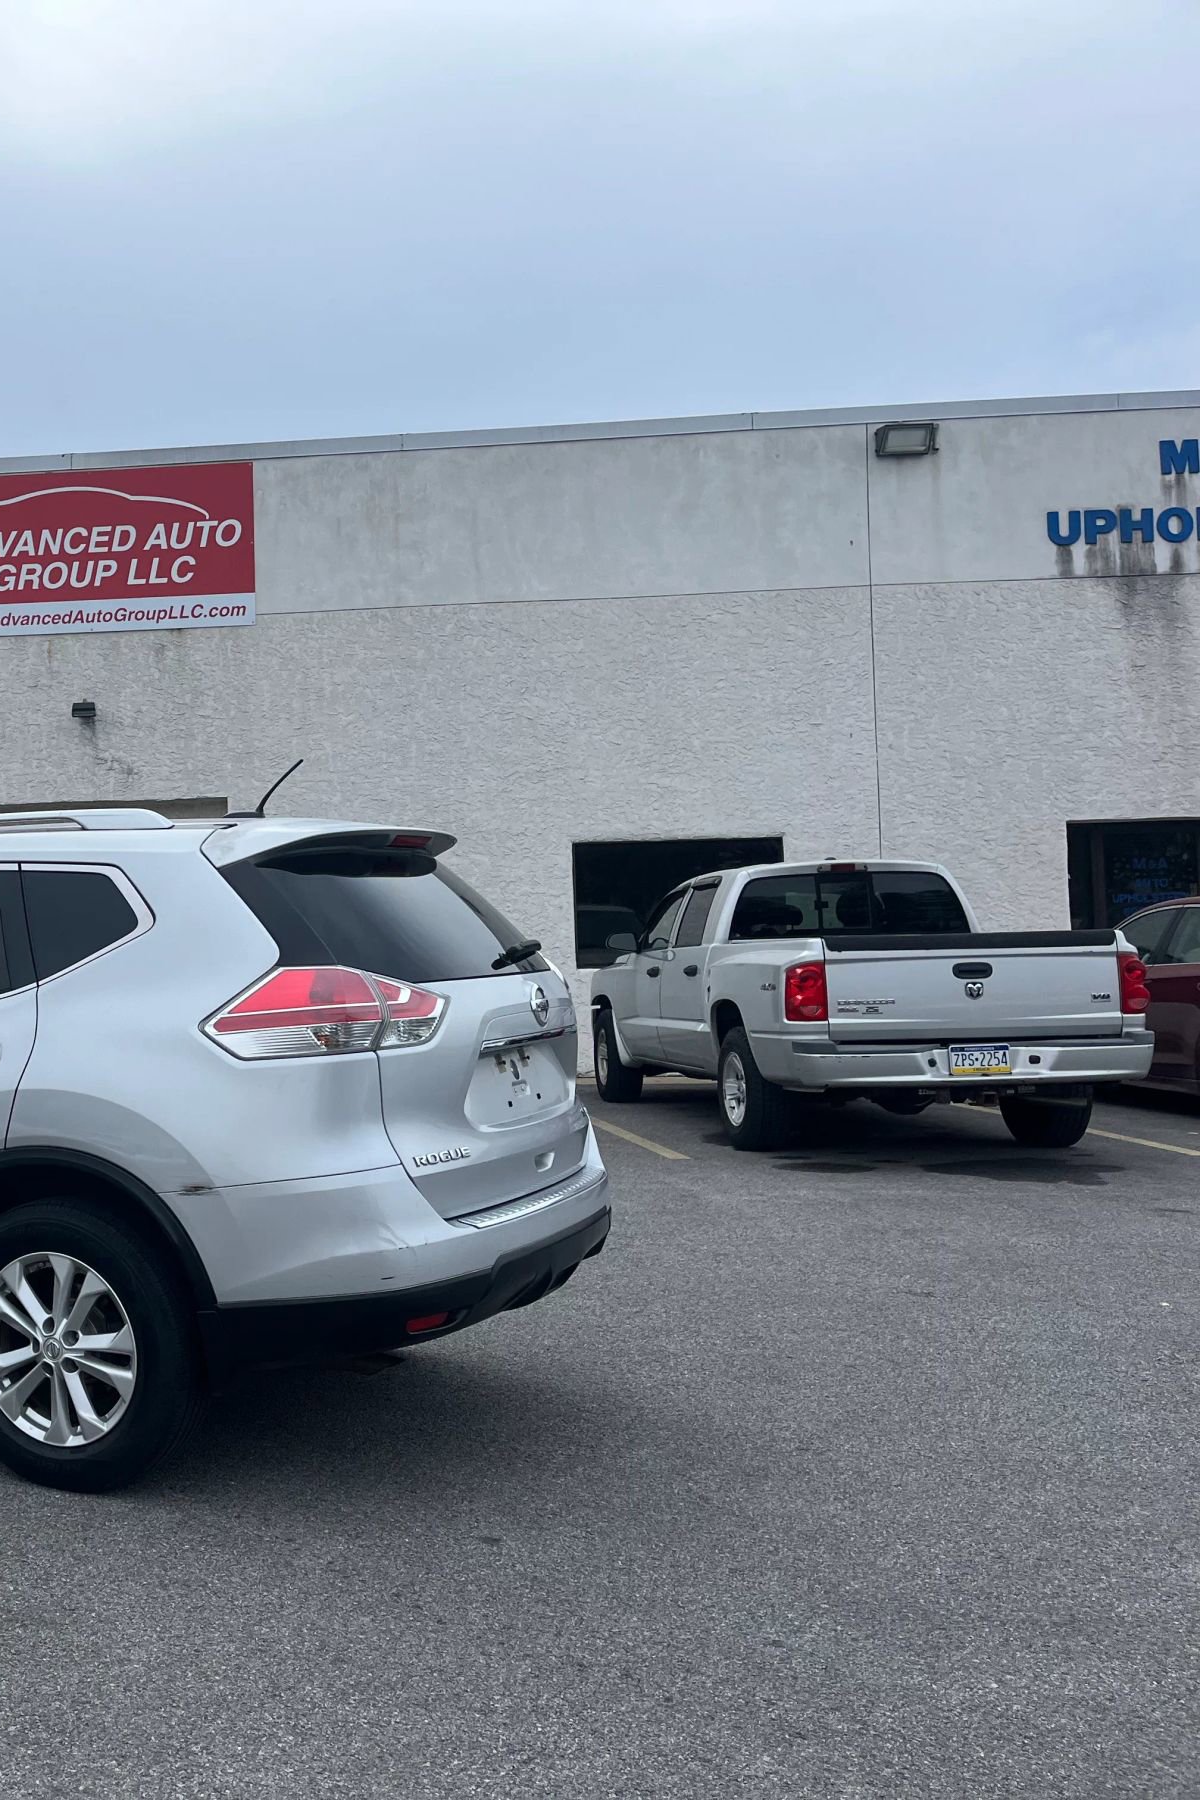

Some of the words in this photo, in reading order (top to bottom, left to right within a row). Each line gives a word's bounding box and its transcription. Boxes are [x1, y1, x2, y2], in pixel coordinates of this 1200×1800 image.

[143, 518, 242, 550] AUTO
[1046, 507, 1200, 546] UPHO
[127, 555, 196, 585] LLC
[412, 1147, 471, 1168] ROGUE
